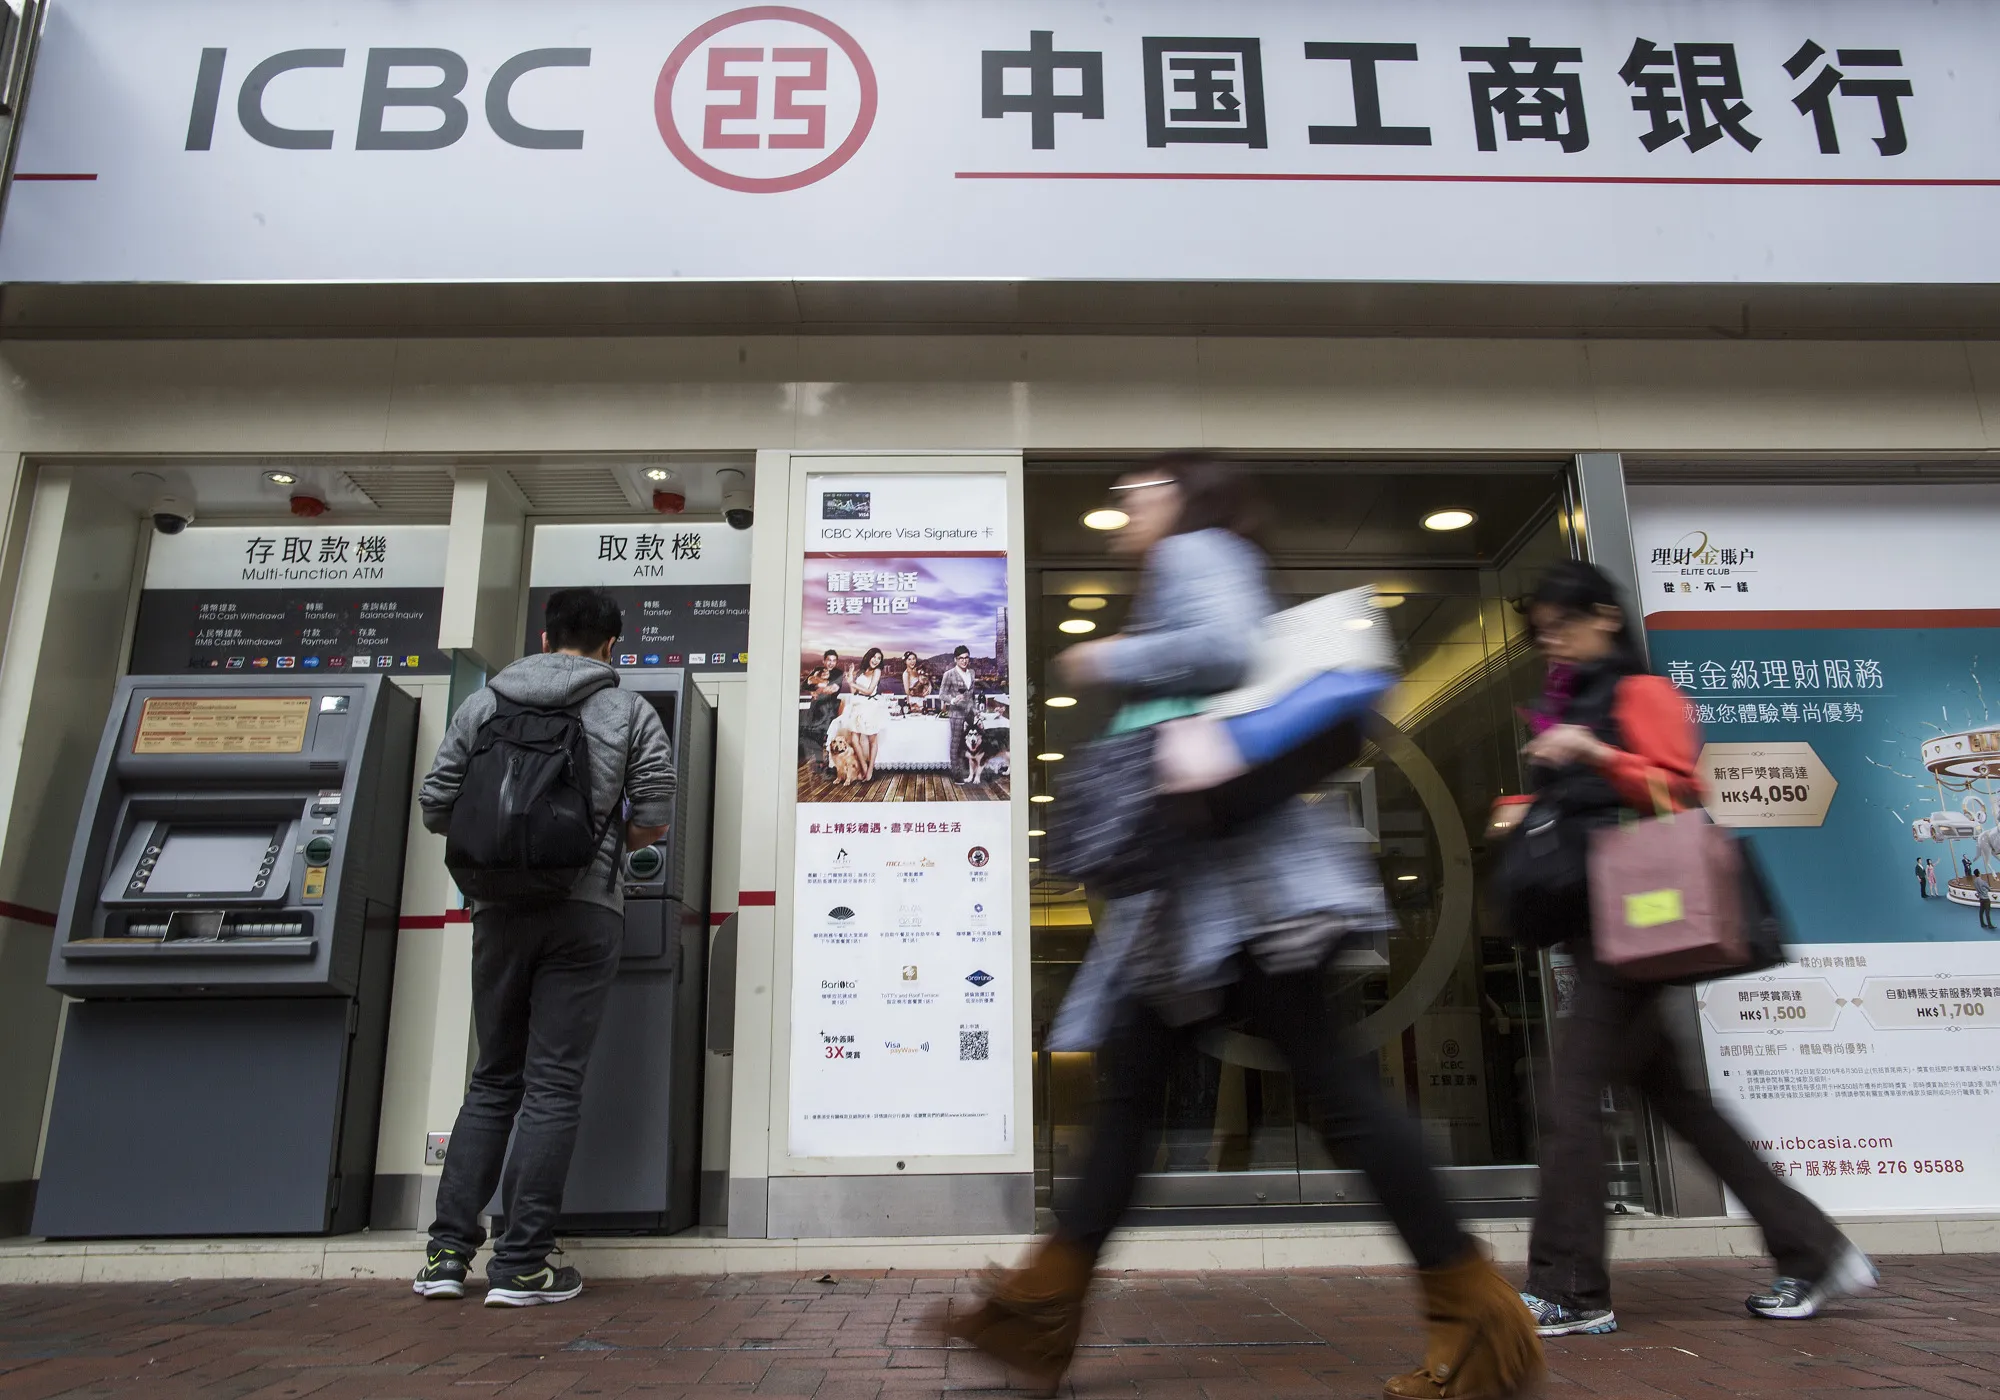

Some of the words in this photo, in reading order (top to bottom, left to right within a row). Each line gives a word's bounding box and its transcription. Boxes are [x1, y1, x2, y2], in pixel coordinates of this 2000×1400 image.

[982, 31, 1913, 156] 中国工商银行
[185, 48, 591, 151] ICBC
[821, 528, 852, 539] ICBC
[855, 528, 892, 541] Xplore
[896, 528, 920, 538] Visa
[924, 527, 978, 541] Signature
[982, 526, 994, 539] 卡
[246, 536, 386, 564] 存取款機
[598, 533, 701, 561] 取款機
[242, 568, 348, 580] Multi-function
[353, 567, 384, 579] ATM
[633, 565, 664, 576] ATM
[1707, 568, 1730, 576] CLUB
[827, 570, 919, 592] 寵愛生活
[217, 612, 238, 620] Cash
[241, 612, 285, 620] Withdrawal
[305, 612, 336, 620] Transfer
[360, 611, 394, 619] Balance
[396, 611, 423, 620] Inquiry
[693, 608, 725, 616] Balance
[303, 628, 320, 637] 付款
[359, 628, 376, 637] 存款
[642, 626, 659, 635] 付款
[214, 638, 235, 646] Cash
[237, 638, 282, 646] Withdrawal
[301, 638, 338, 646] Payment
[357, 637, 389, 645] Deposit
[641, 635, 675, 643] Payment
[1668, 659, 1883, 690] 黃金級理財服務
[1740, 1006, 1806, 1022] HK$1,500
[1917, 1003, 1985, 1019] HK$1,700
[885, 1041, 900, 1049] Visa
[825, 1046, 844, 1059] 3X
[1744, 1136, 1893, 1150] ww.icbcasia.com
[1765, 1160, 1872, 1177] 客户服務熱線
[1878, 1161, 1907, 1175] 276
[1914, 1160, 1965, 1174] 95588
